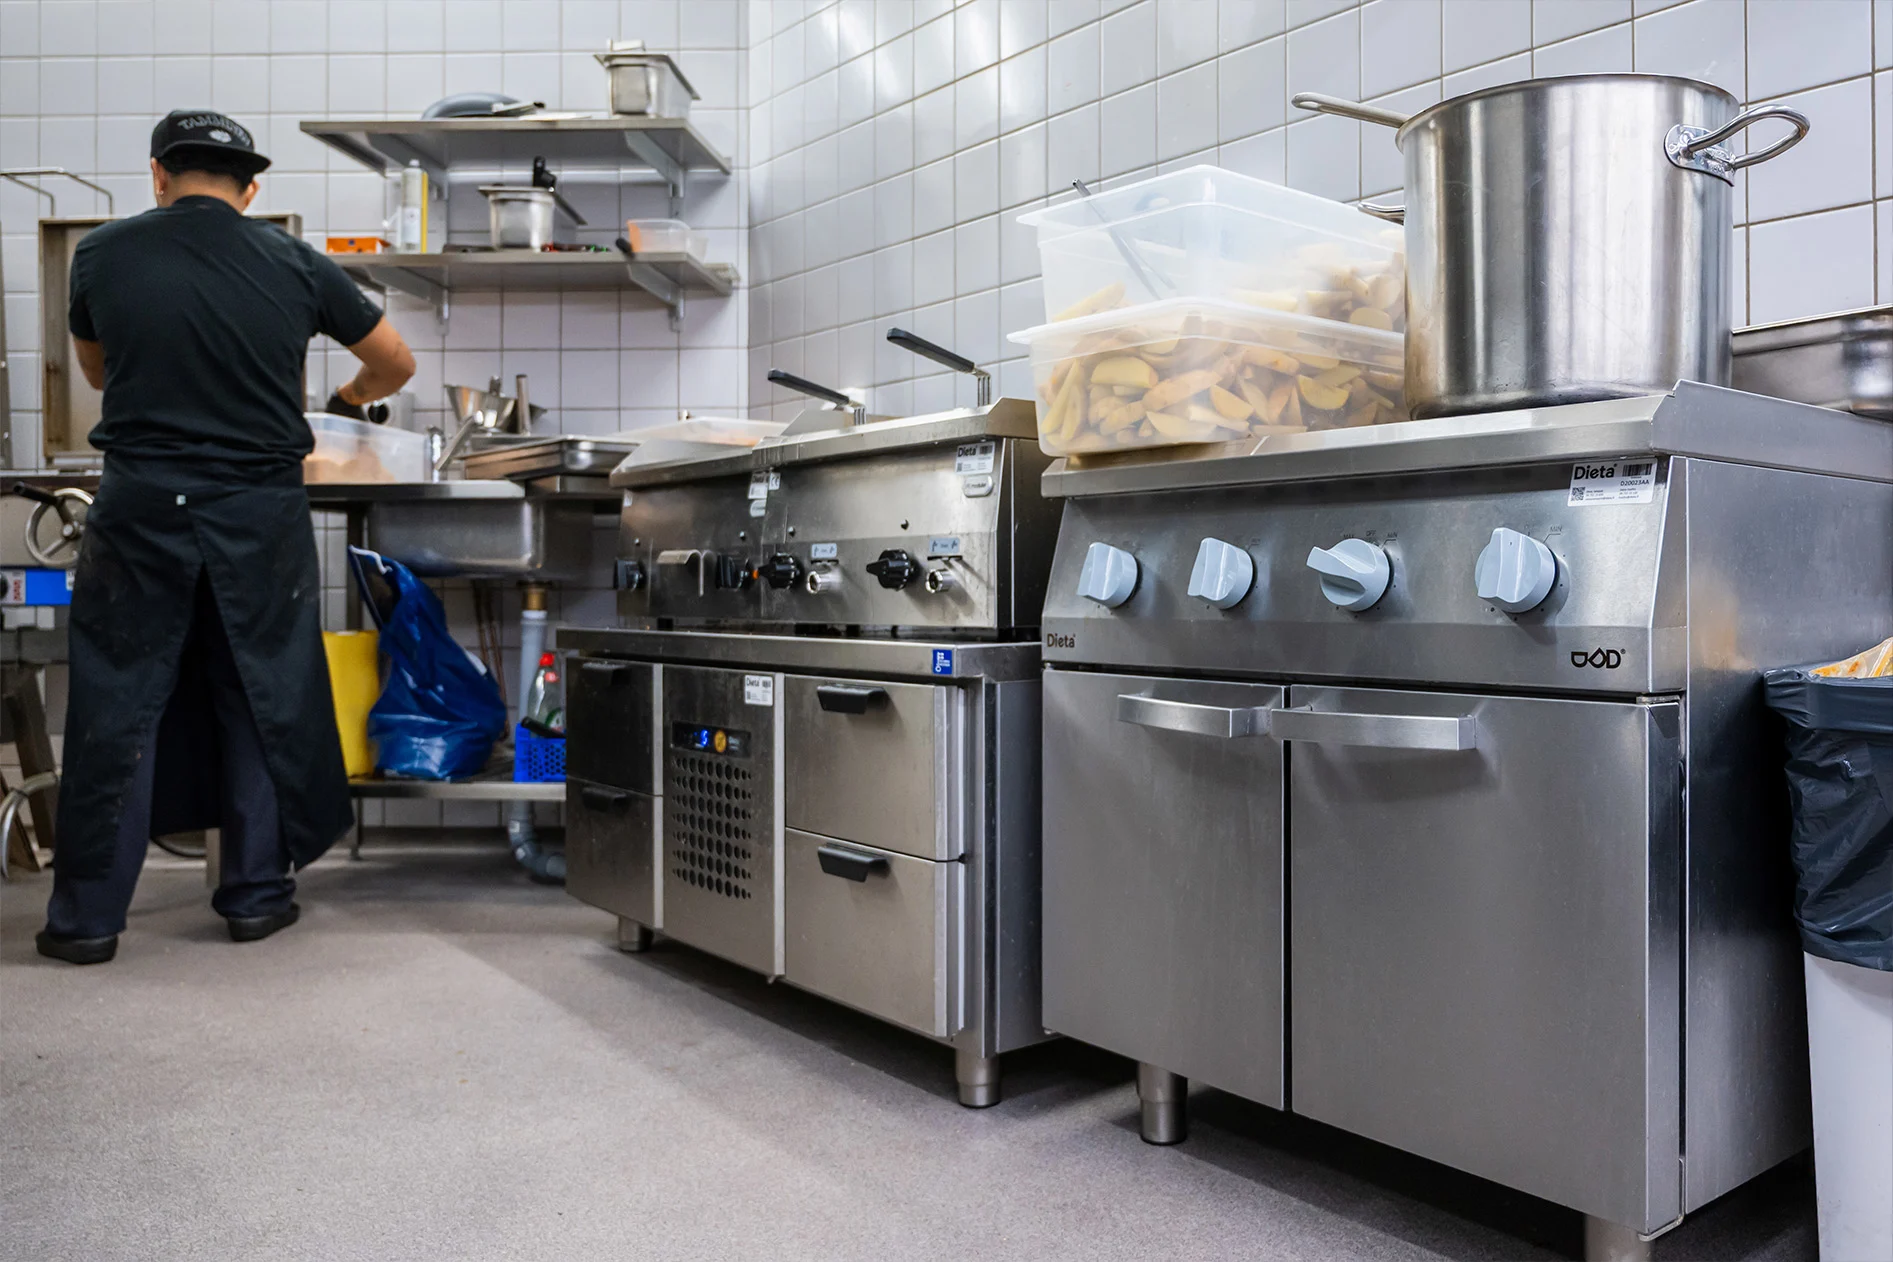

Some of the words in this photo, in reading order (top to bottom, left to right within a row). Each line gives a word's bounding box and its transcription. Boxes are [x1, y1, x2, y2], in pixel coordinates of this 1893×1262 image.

[1573, 464, 1616, 481] Dieta
[1620, 479, 1650, 487] D20023AA
[1047, 633, 1075, 648] Dieta
